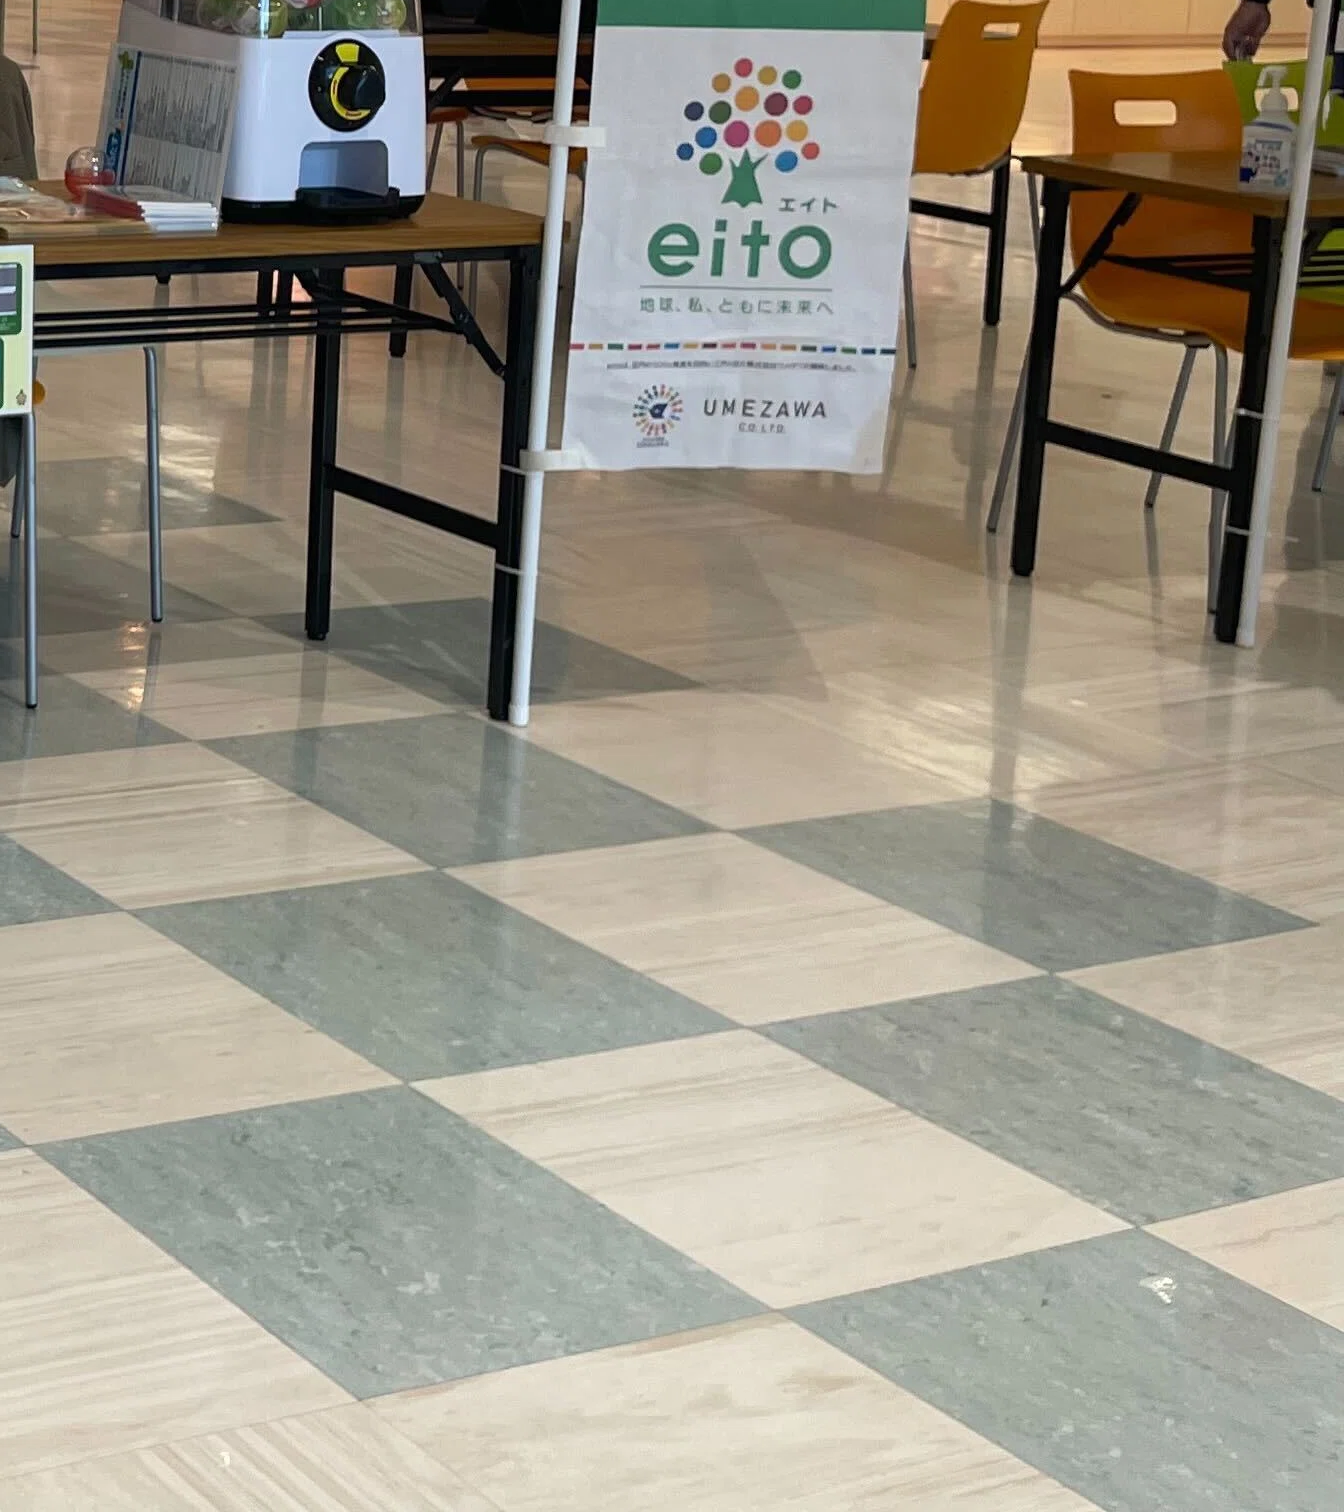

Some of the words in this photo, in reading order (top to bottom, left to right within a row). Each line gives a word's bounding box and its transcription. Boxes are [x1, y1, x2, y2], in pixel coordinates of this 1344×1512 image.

[779, 197, 840, 213] エイト
[647, 219, 833, 279] eito
[640, 297, 834, 316] 地球、私、ともに未来へ
[703, 399, 827, 419] UMEZAWA
